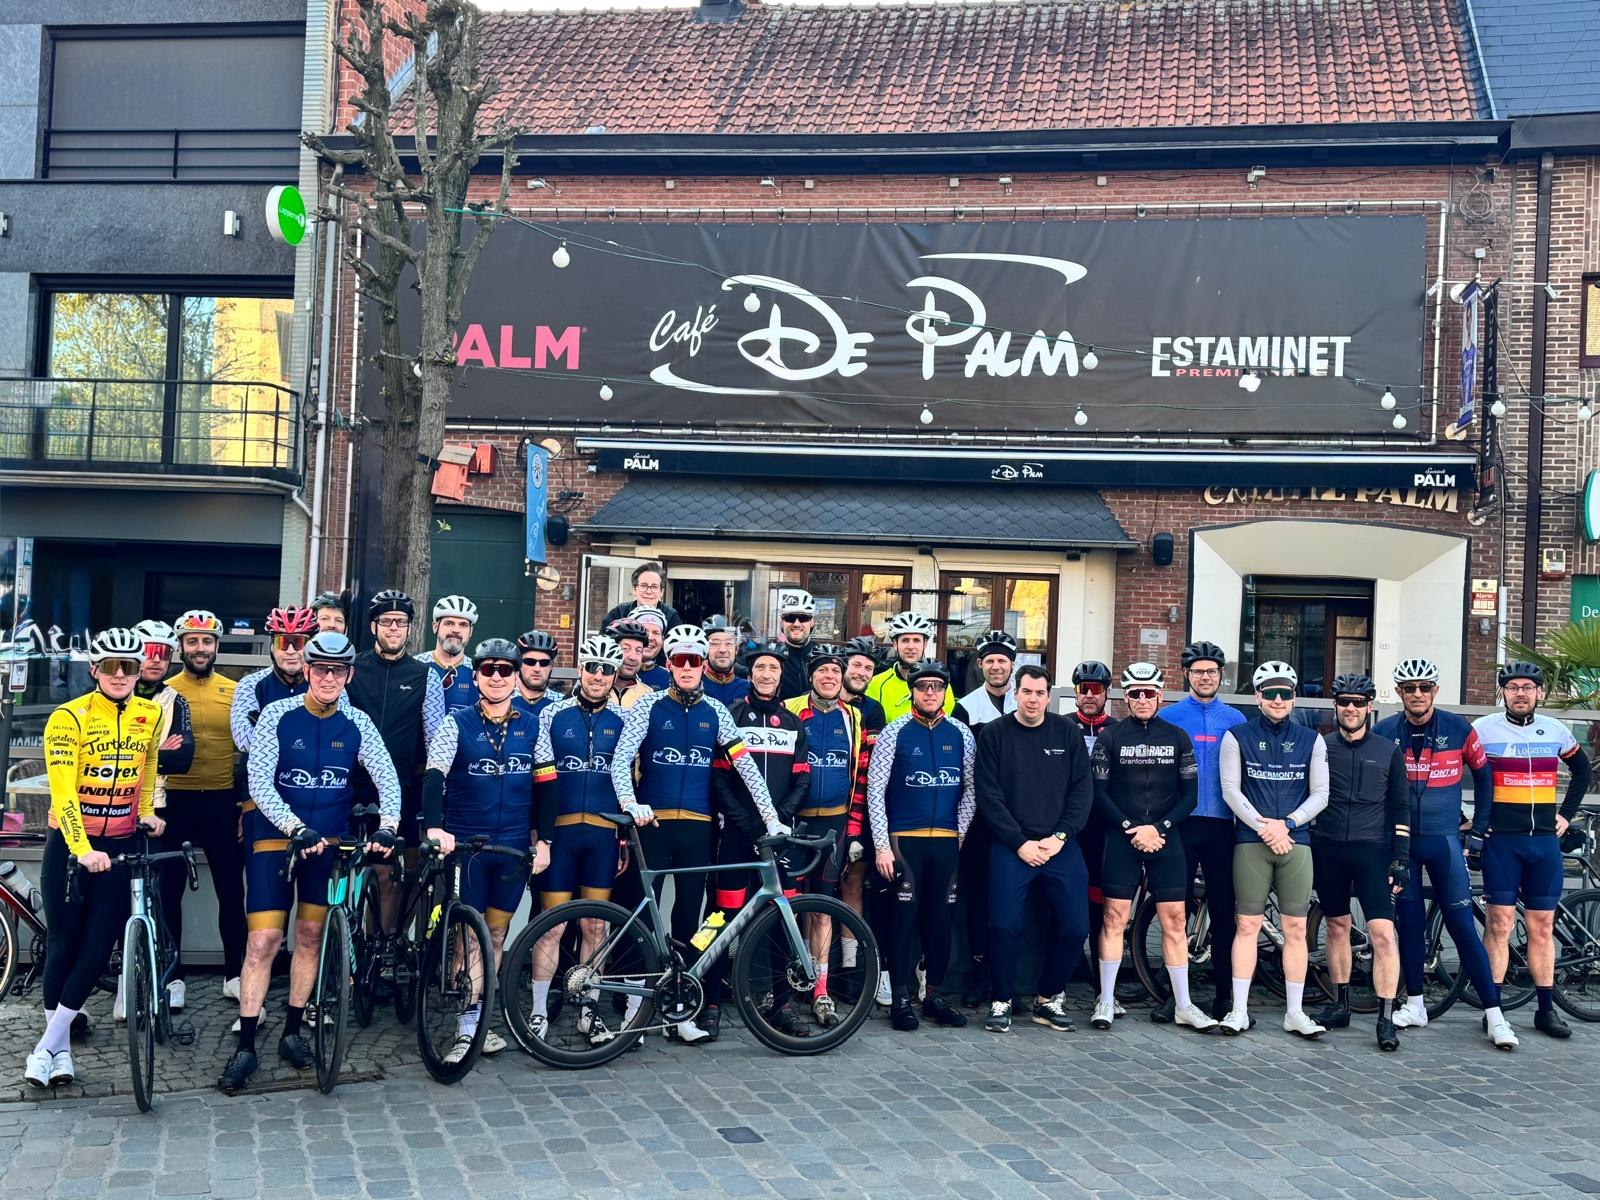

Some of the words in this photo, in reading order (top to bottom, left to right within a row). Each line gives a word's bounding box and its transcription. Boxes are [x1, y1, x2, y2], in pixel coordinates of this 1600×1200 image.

[650, 304, 719, 357] Café
[452, 323, 581, 370] ALM
[1152, 336, 1351, 377] ESTAMINET
[624, 458, 660, 471] PALM
[1414, 474, 1456, 487] PALM
[83, 763, 140, 779] isorex
[81, 804, 100, 815] Van
